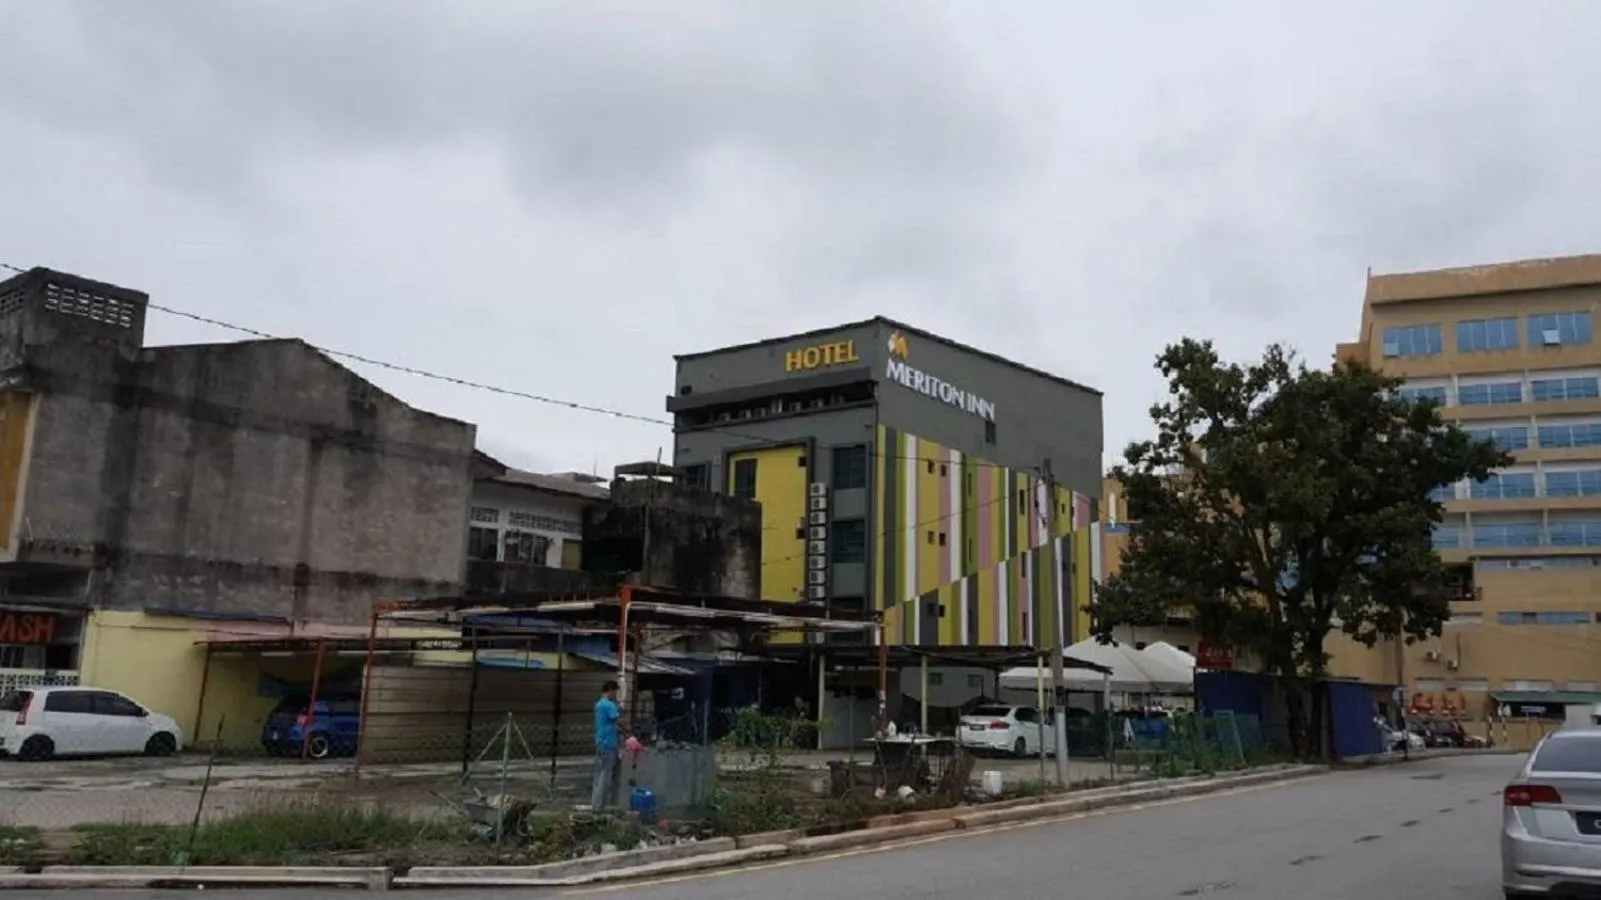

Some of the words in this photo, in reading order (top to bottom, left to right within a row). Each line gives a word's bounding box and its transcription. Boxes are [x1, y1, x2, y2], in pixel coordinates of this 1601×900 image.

[785, 340, 858, 372] HOTEL
[886, 357, 965, 409] MERITON
[967, 393, 995, 421] INN
